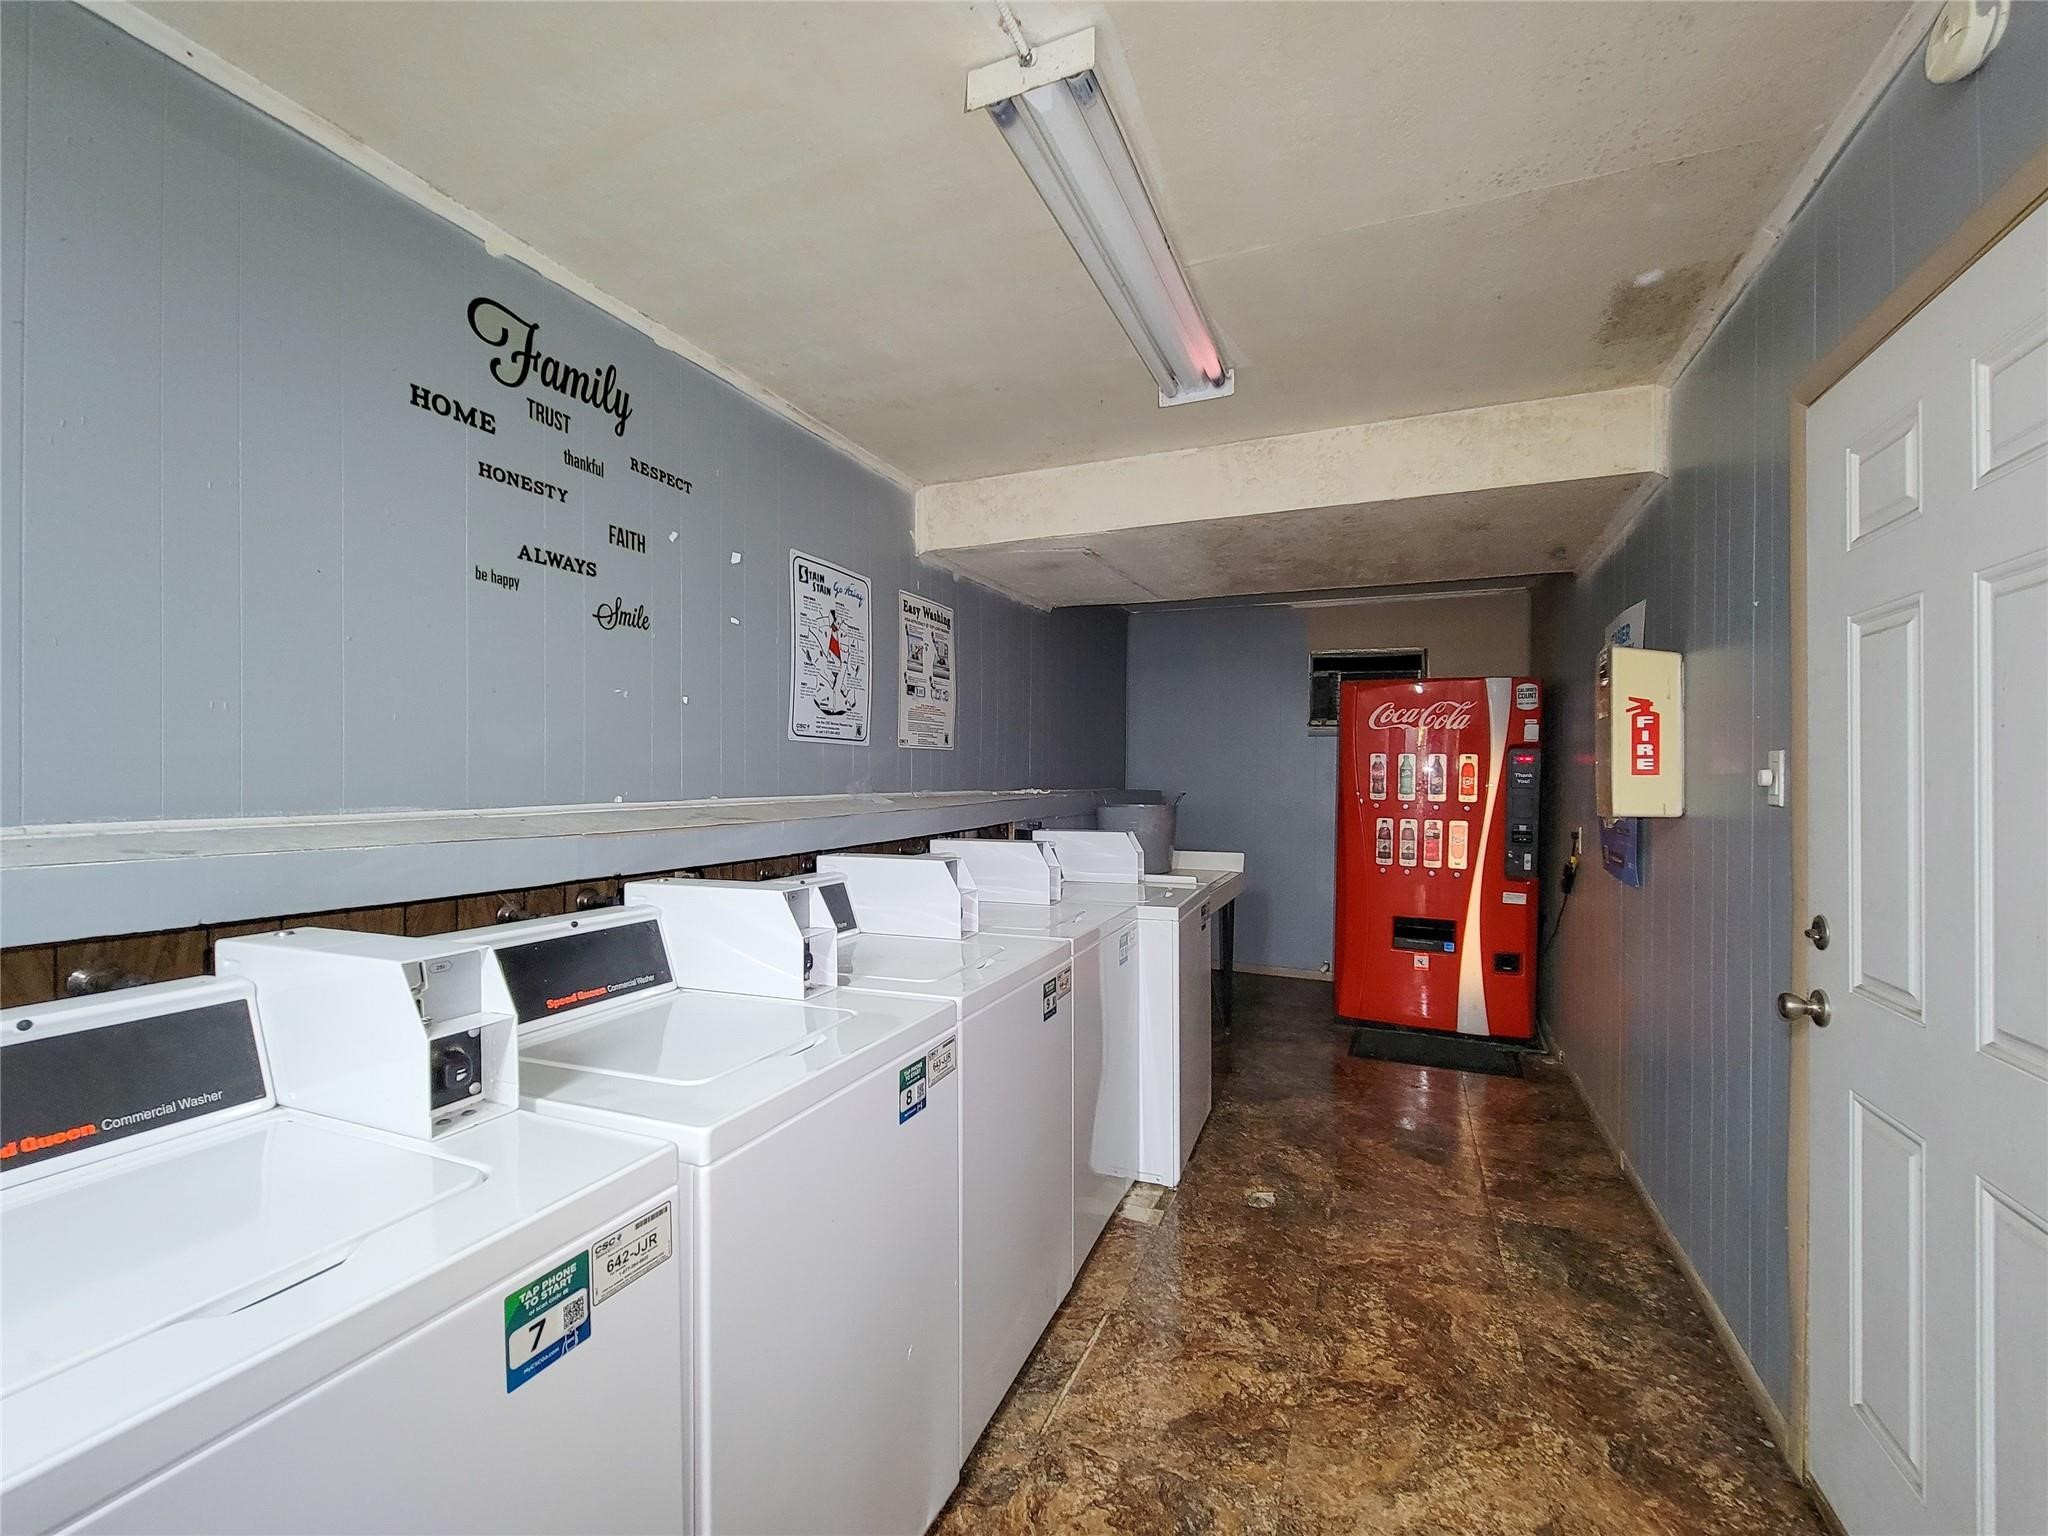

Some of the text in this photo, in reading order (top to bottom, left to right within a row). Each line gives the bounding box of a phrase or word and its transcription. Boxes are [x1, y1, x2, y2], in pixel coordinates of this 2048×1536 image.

[467, 297, 633, 436] Family
[410, 383, 496, 435] HOME
[527, 398, 571, 434] TRUST
[563, 449, 604, 478] thankful
[630, 457, 693, 494] RESPECT
[478, 462, 568, 503] HONESTY
[608, 525, 646, 554] FAITH
[517, 545, 597, 577] ALWAYS
[799, 564, 824, 583] STAIN
[475, 566, 520, 591] be happy
[813, 582, 831, 596] STAIN
[592, 597, 650, 631] Smile
[903, 599, 920, 620] Easy
[922, 606, 951, 630] Washing
[1369, 700, 1477, 730] Coca-Cola
[1636, 715, 1654, 770] FIRE
[607, 979, 636, 993] Commercial
[101, 1100, 176, 1131] Commercial
[177, 1090, 223, 1110] Washer
[906, 1089, 912, 1106] 8
[595, 1237, 616, 1254] CSC
[607, 1233, 658, 1273] 642-JJR
[519, 1286, 540, 1304] TAP
[542, 1262, 577, 1286] PHONE
[523, 1274, 573, 1310] TO START
[529, 1318, 546, 1352] 7
